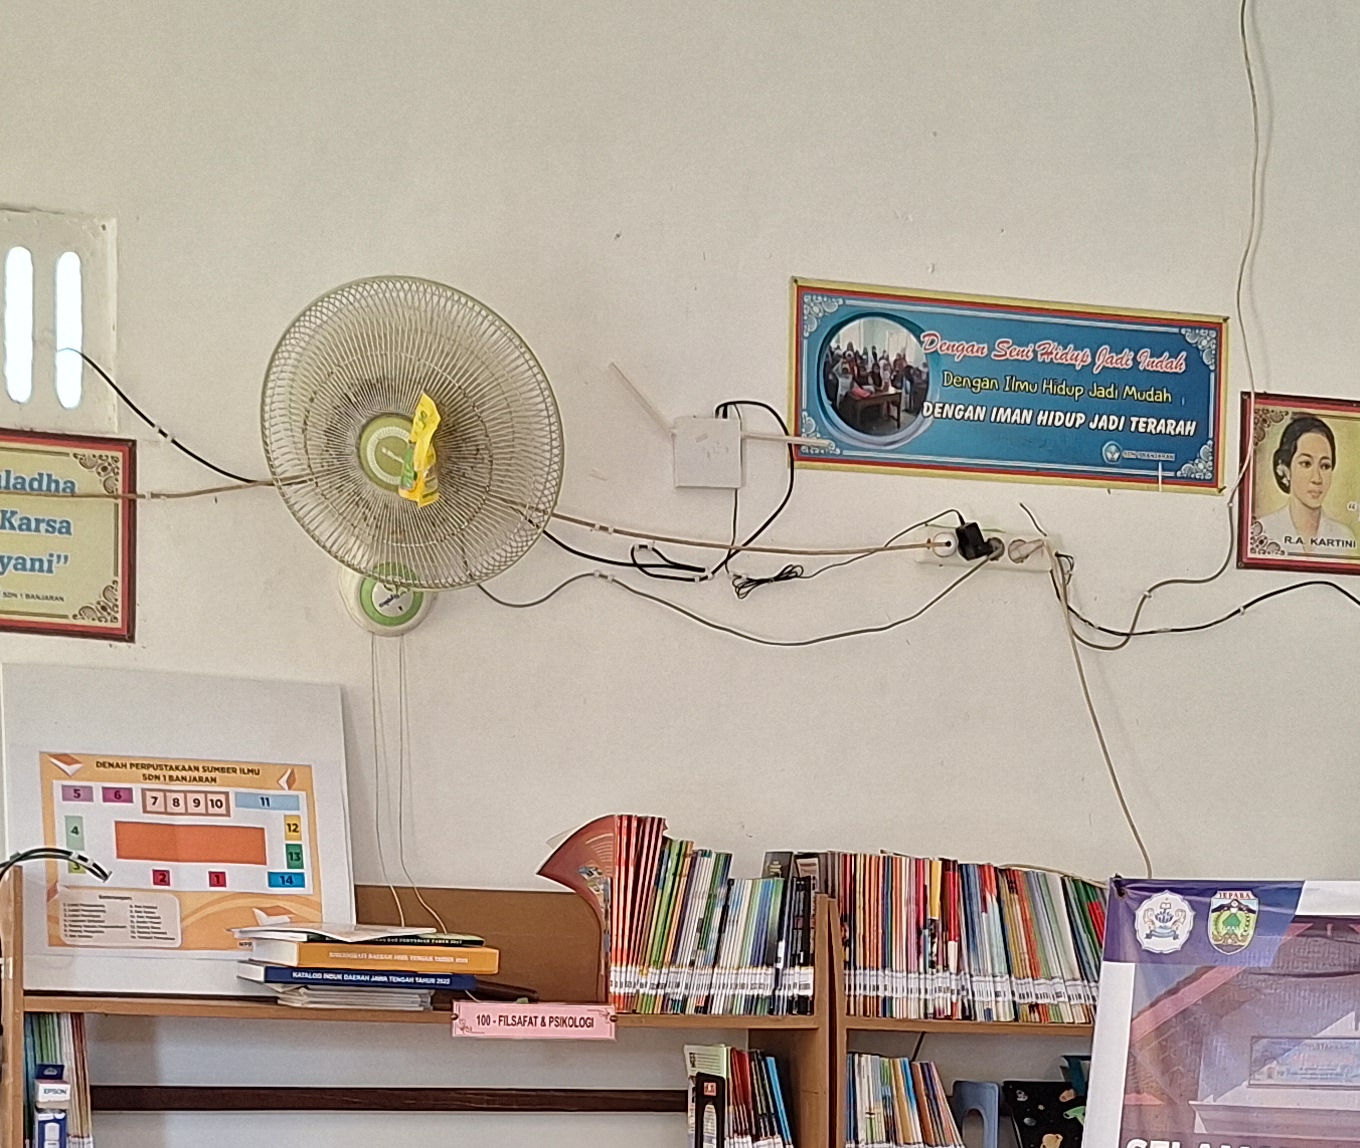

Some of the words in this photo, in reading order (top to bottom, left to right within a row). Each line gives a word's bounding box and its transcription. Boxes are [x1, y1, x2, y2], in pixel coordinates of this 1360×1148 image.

[921, 332, 988, 359] Dengan
[991, 337, 1032, 362] Seni
[1036, 342, 1092, 371] Hidup
[1093, 346, 1133, 374] Jadi
[1139, 351, 1187, 374] Indah
[942, 370, 999, 395] Dengan
[1003, 374, 1038, 394] Ilmu
[1042, 379, 1084, 401] Hidup
[1090, 382, 1119, 401] Jadi
[1122, 386, 1172, 403] Mudah
[922, 400, 984, 421] DENGAN
[990, 407, 1032, 426] IMAN
[1037, 410, 1085, 430] HIDUP
[1088, 415, 1125, 432] JADI
[1130, 416, 1197, 436] TERARAH
[1310, 537, 1356, 548] KARTINI
[96, 761, 127, 770] DENAH
[129, 762, 200, 773] PERPUSTAKAAN
[202, 765, 237, 774] SUMBER
[239, 767, 260, 776] ILMU
[142, 773, 161, 782] SDN
[168, 775, 217, 784] BANJARAN
[476, 1015, 491, 1026] 100
[498, 1015, 538, 1027] FILSAFAT
[539, 1016, 546, 1027] &
[548, 1016, 594, 1029] PSIKOLOGI
